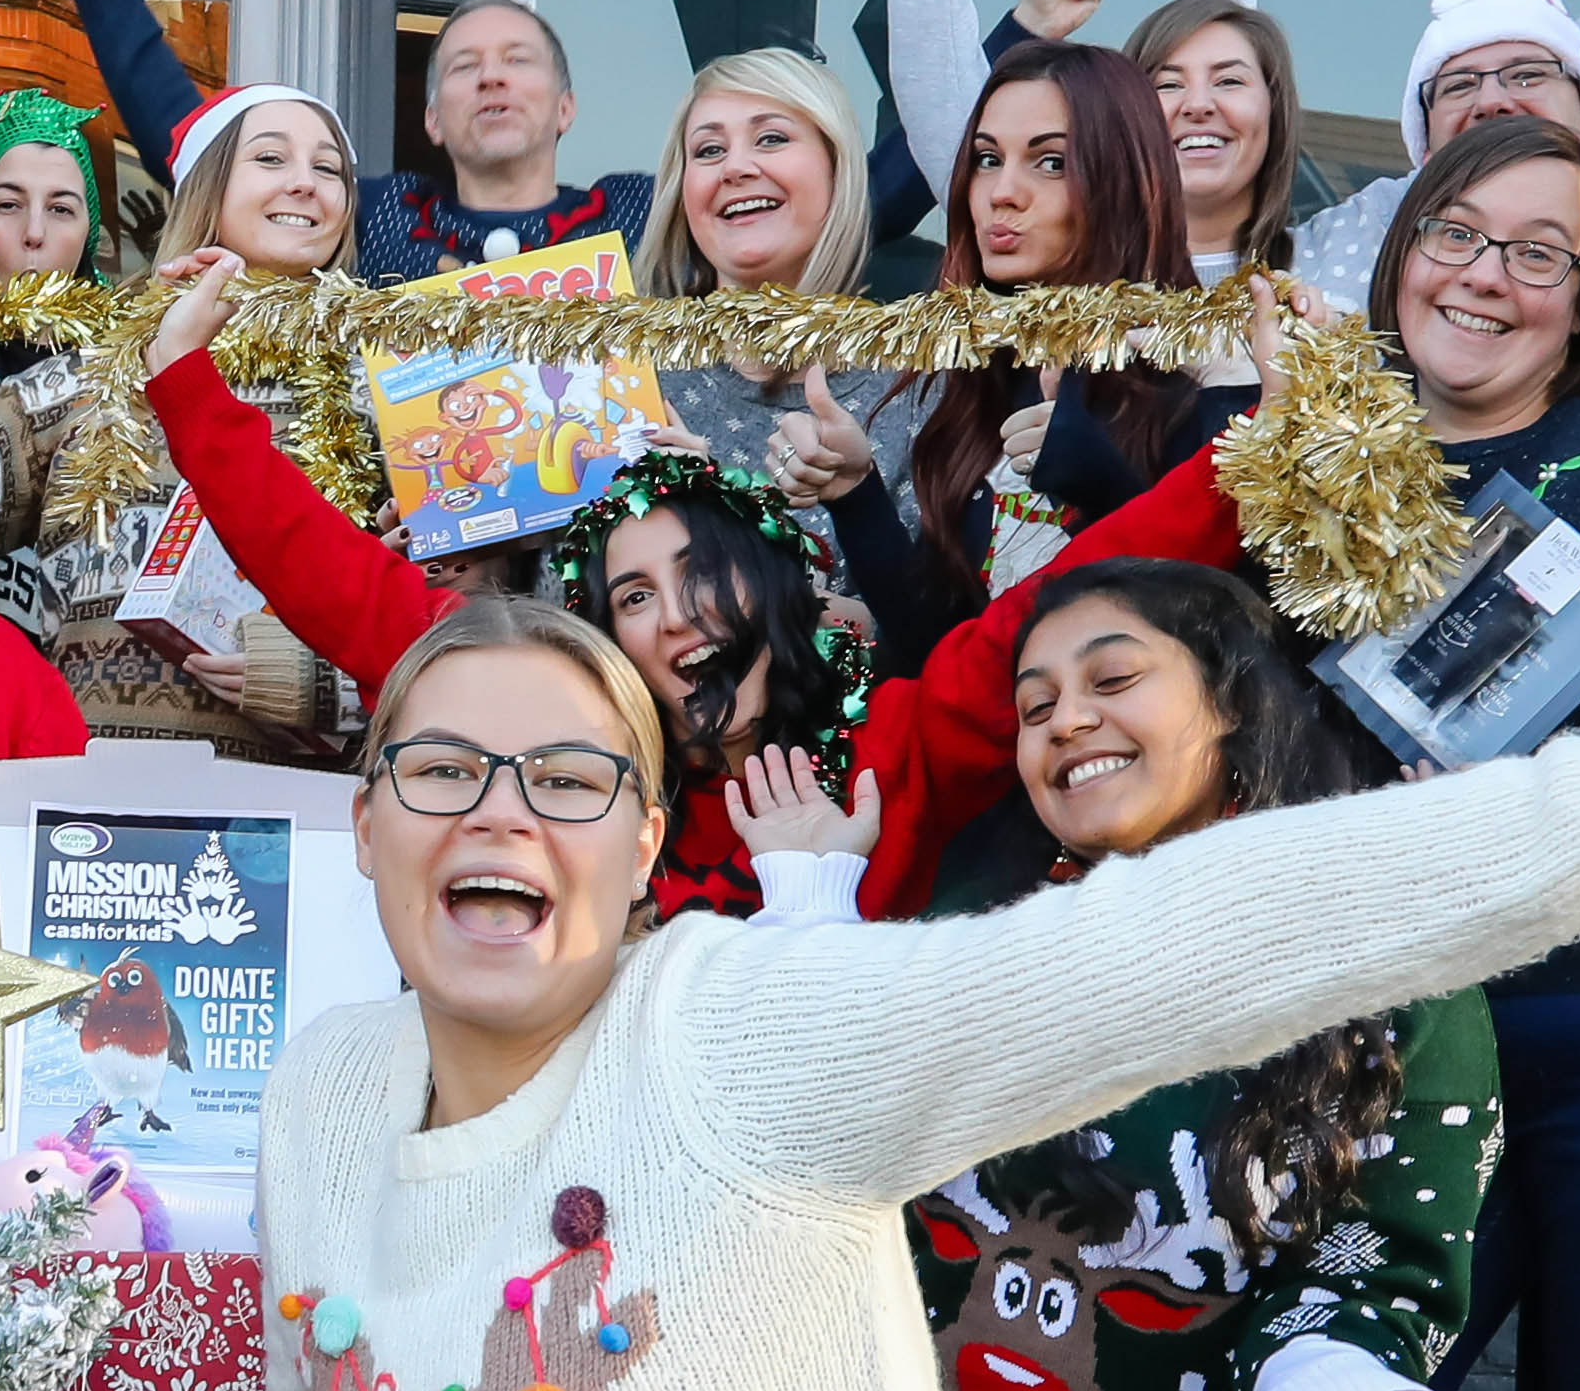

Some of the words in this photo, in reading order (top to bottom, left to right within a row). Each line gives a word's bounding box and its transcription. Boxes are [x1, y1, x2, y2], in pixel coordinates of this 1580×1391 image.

[458, 252, 619, 302] Face!
[59, 832, 92, 843] wave
[47, 860, 177, 896] MISSION
[45, 894, 177, 920] CHRISTMAS
[44, 922, 174, 942] cashforkids
[174, 965, 276, 1000] DONATE
[201, 1002, 275, 1036] GIFTS
[205, 1037, 273, 1071] HERE
[190, 1087, 207, 1098] New
[210, 1087, 225, 1098] and
[196, 1102, 220, 1113] items
[222, 1103, 239, 1114] only
